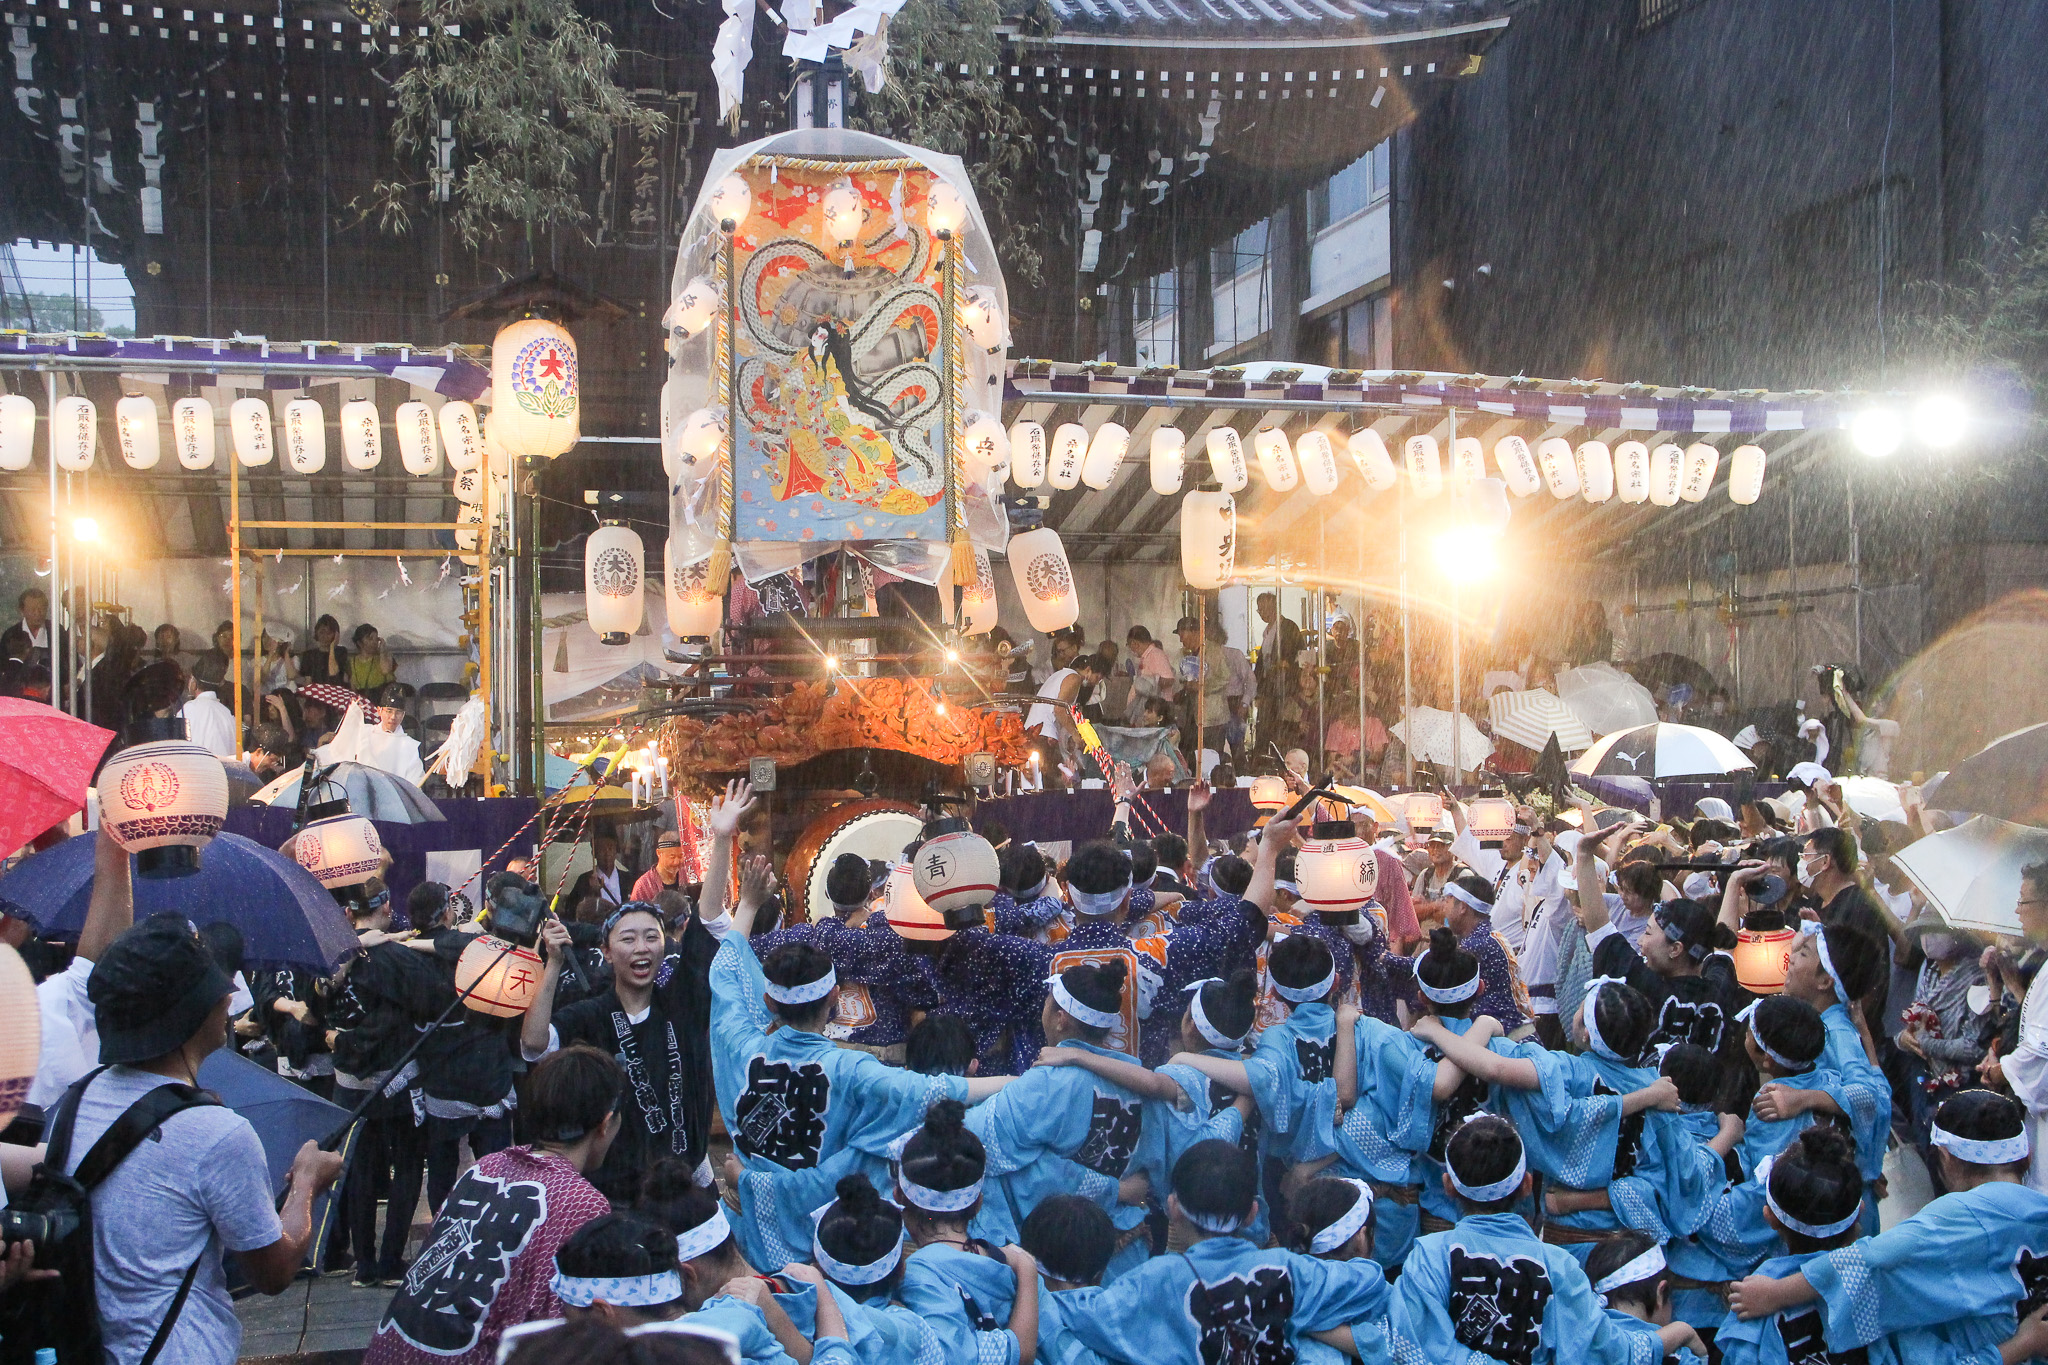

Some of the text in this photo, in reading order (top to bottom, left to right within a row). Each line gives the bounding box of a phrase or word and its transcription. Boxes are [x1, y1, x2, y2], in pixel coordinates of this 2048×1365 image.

[538, 348, 565, 381] 大
[77, 404, 90, 461] 石取祭保存会
[119, 415, 136, 460] 桑名宗社
[182, 406, 200, 460] 石取祭保存会
[250, 411, 267, 451] 桑名宗社
[290, 407, 308, 465] 石取祭保存会
[360, 417, 377, 459] 桑名宗社
[416, 408, 434, 464] 石取祭保存会
[456, 413, 476, 457] 桑名宗社
[1029, 427, 1042, 477] 石取祭保存会
[1059, 438, 1079, 478] 桑名宗社
[1225, 432, 1245, 482] 石取祭保存会
[1272, 444, 1292, 483] 桑名宗社
[1316, 435, 1336, 484] 石取祭保存会
[1511, 438, 1536, 483] 石取祭保存会
[1629, 451, 1642, 488] 桑名宗社
[459, 476, 474, 491] 祭
[1686, 457, 1707, 493] 桑名宗社
[606, 554, 626, 573] 大
[1039, 560, 1058, 580] 大
[925, 853, 947, 880] 青
[510, 968, 535, 995] 天
